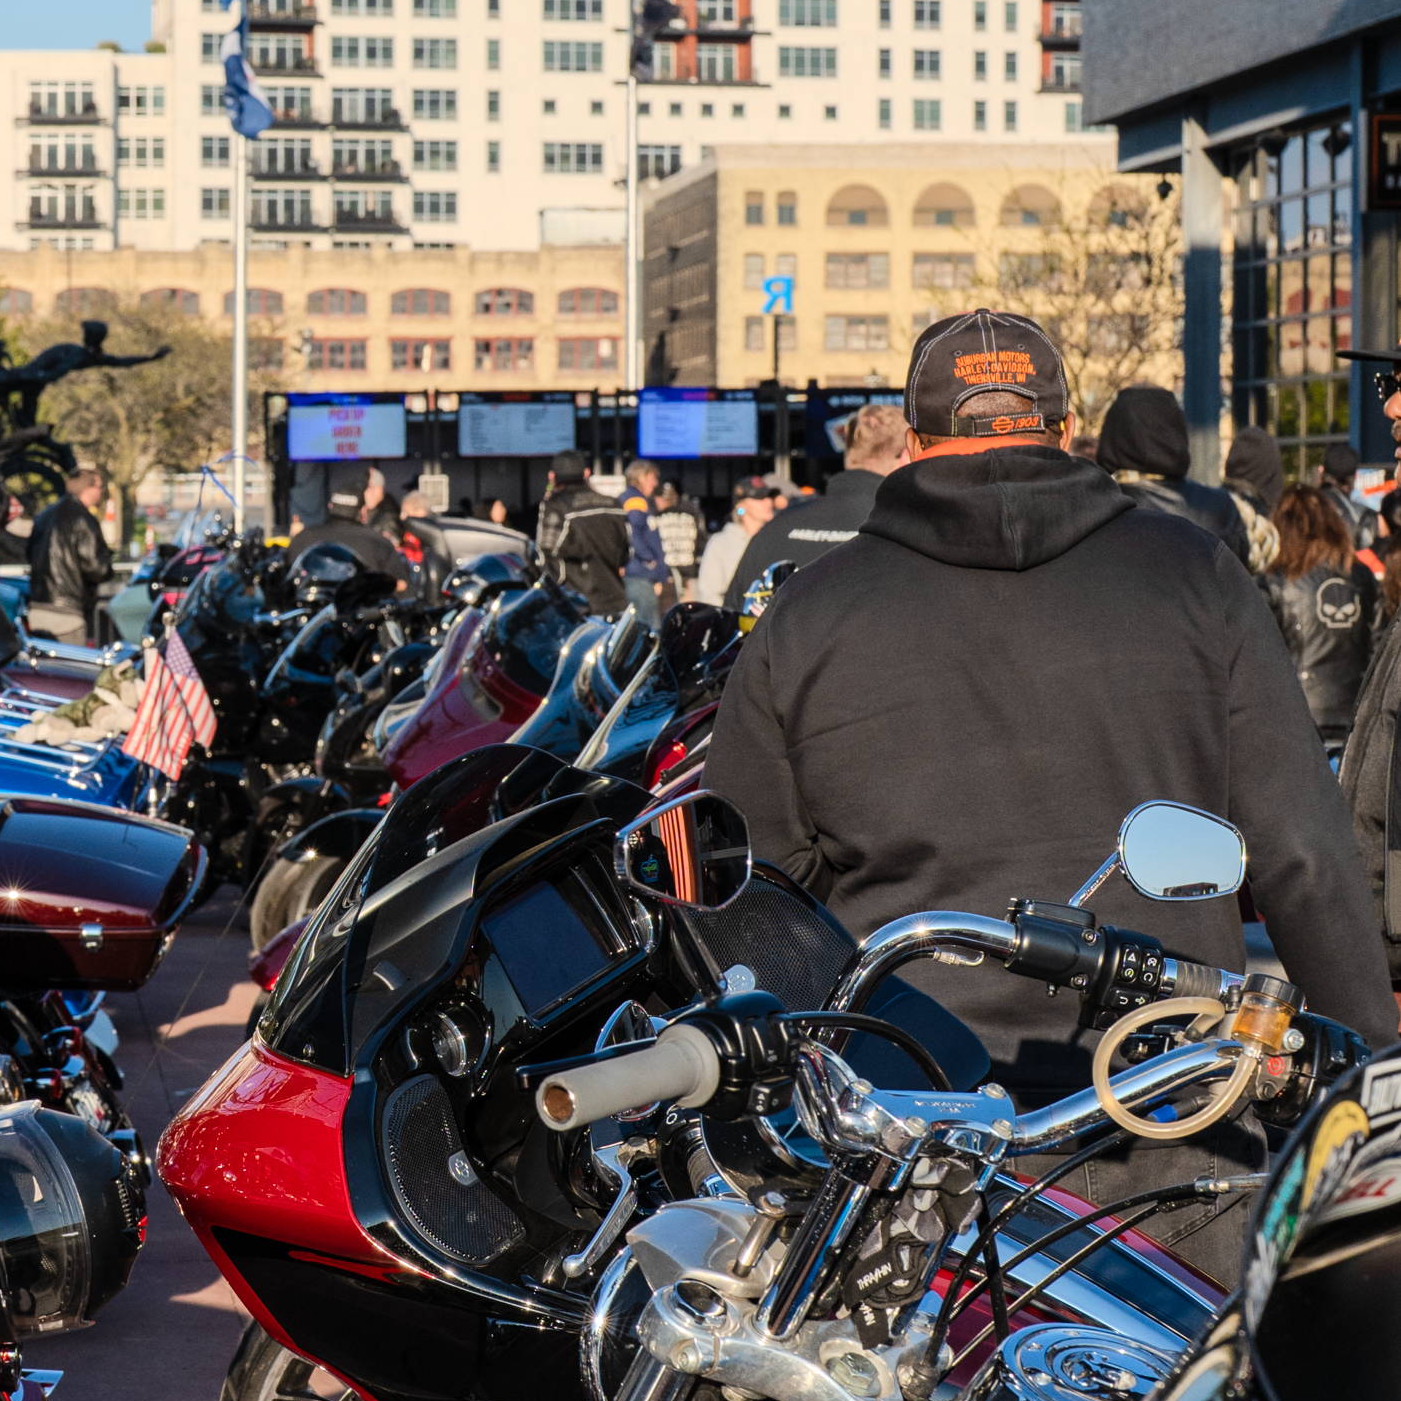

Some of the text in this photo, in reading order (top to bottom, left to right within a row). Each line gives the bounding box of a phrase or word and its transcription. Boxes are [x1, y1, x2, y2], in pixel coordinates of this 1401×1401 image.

[955, 351, 1030, 368] SUBURBAN MOTORS
[963, 373, 1026, 385] THIENSVILLE, WI
[1015, 416, 1039, 429] 1903
